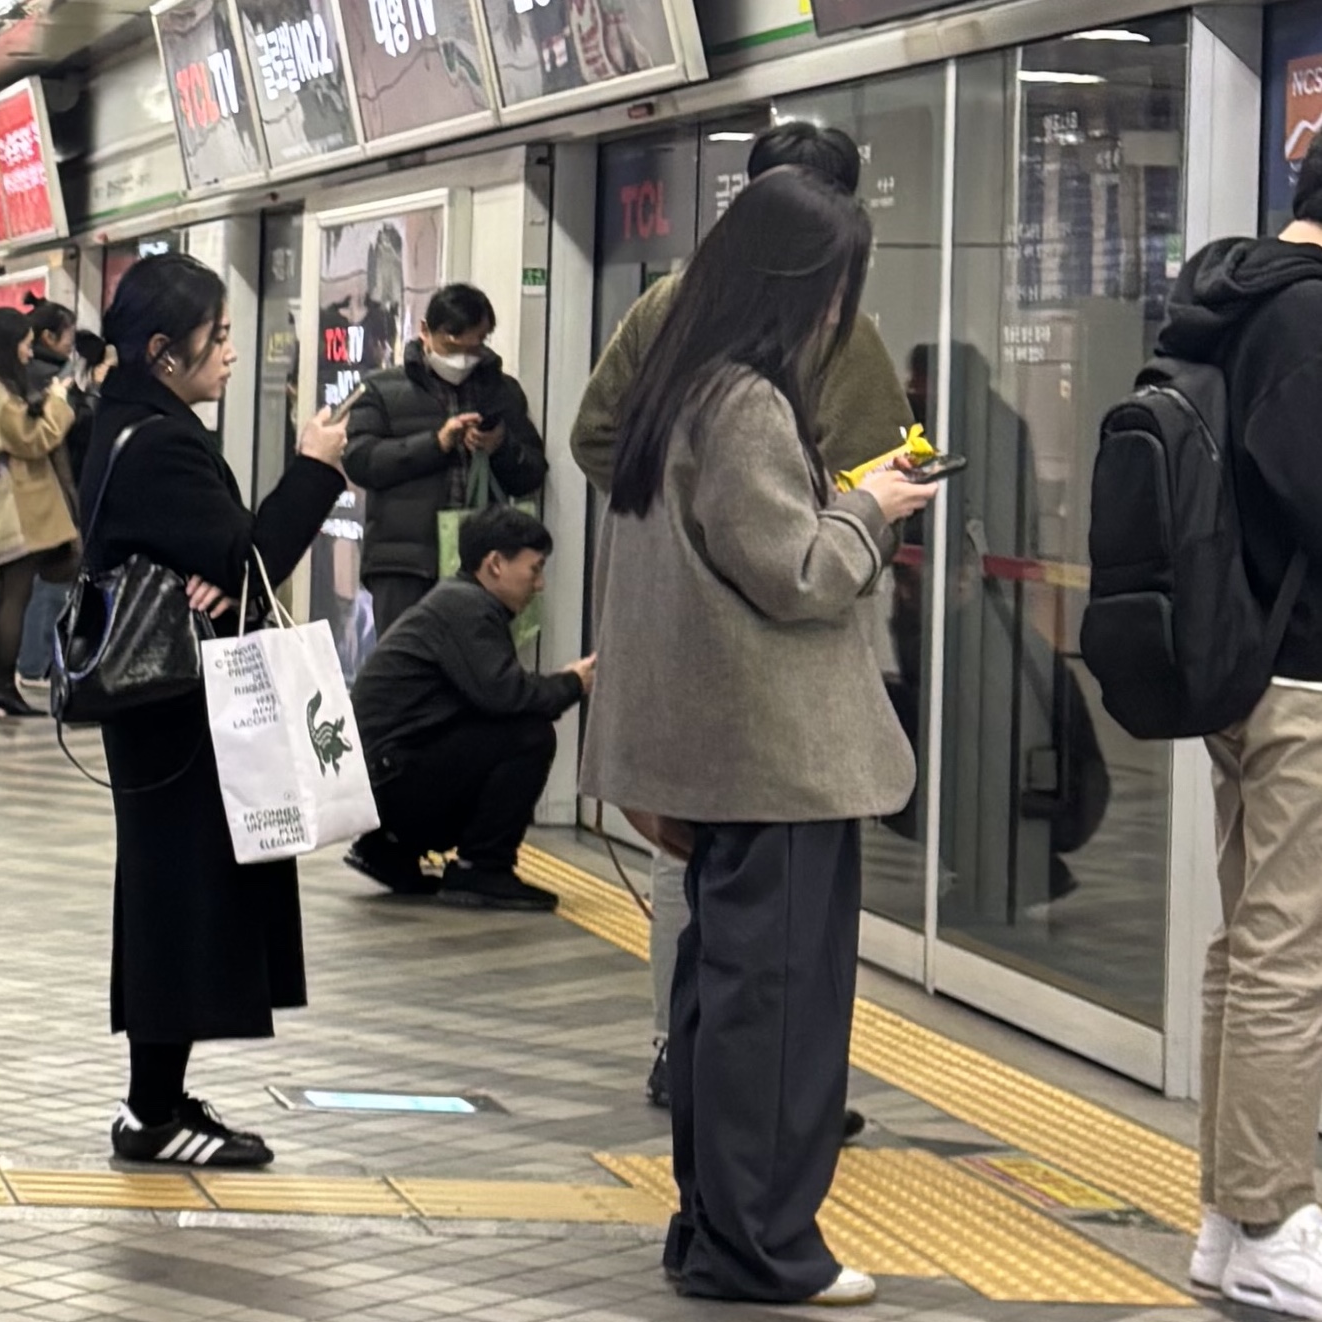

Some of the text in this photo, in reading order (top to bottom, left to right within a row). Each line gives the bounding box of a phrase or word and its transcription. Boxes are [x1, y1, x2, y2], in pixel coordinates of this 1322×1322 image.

[176, 61, 220, 130] TCL
[620, 178, 673, 240] TCL
[325, 326, 348, 362] TCL
[233, 713, 279, 729] LACOSTE
